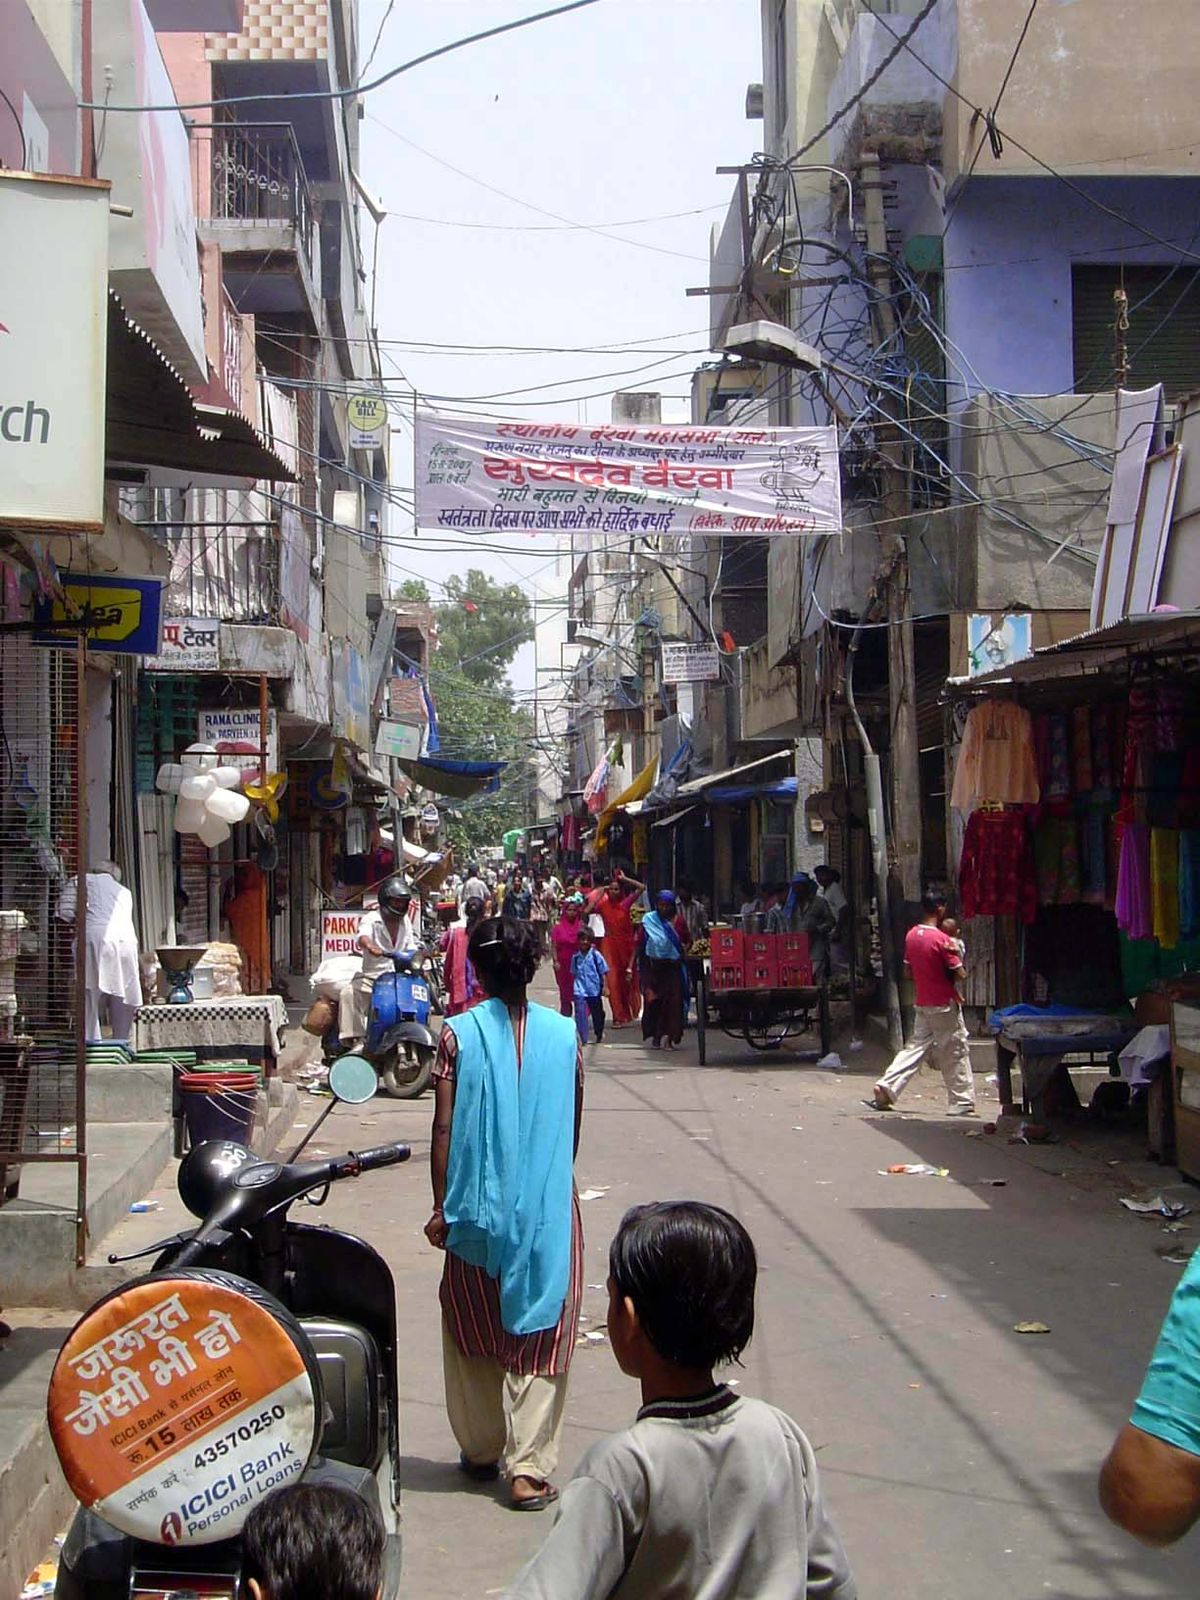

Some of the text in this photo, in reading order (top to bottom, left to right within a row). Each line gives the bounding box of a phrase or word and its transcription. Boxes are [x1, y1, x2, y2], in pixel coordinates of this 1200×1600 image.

[0, 400, 50, 444] ch
[355, 400, 378, 409] EASY
[357, 408, 376, 416] BILL
[184, 626, 215, 646] टेलर
[150, 1336, 197, 1386] भी
[194, 1310, 241, 1359] हो
[111, 1427, 137, 1447] ICICI
[138, 1410, 166, 1433] Bank
[145, 1427, 177, 1452] 15
[194, 1404, 285, 1470] 43570250
[180, 1441, 294, 1521] ICICI Bank
[187, 1459, 303, 1537] Personal Loans
